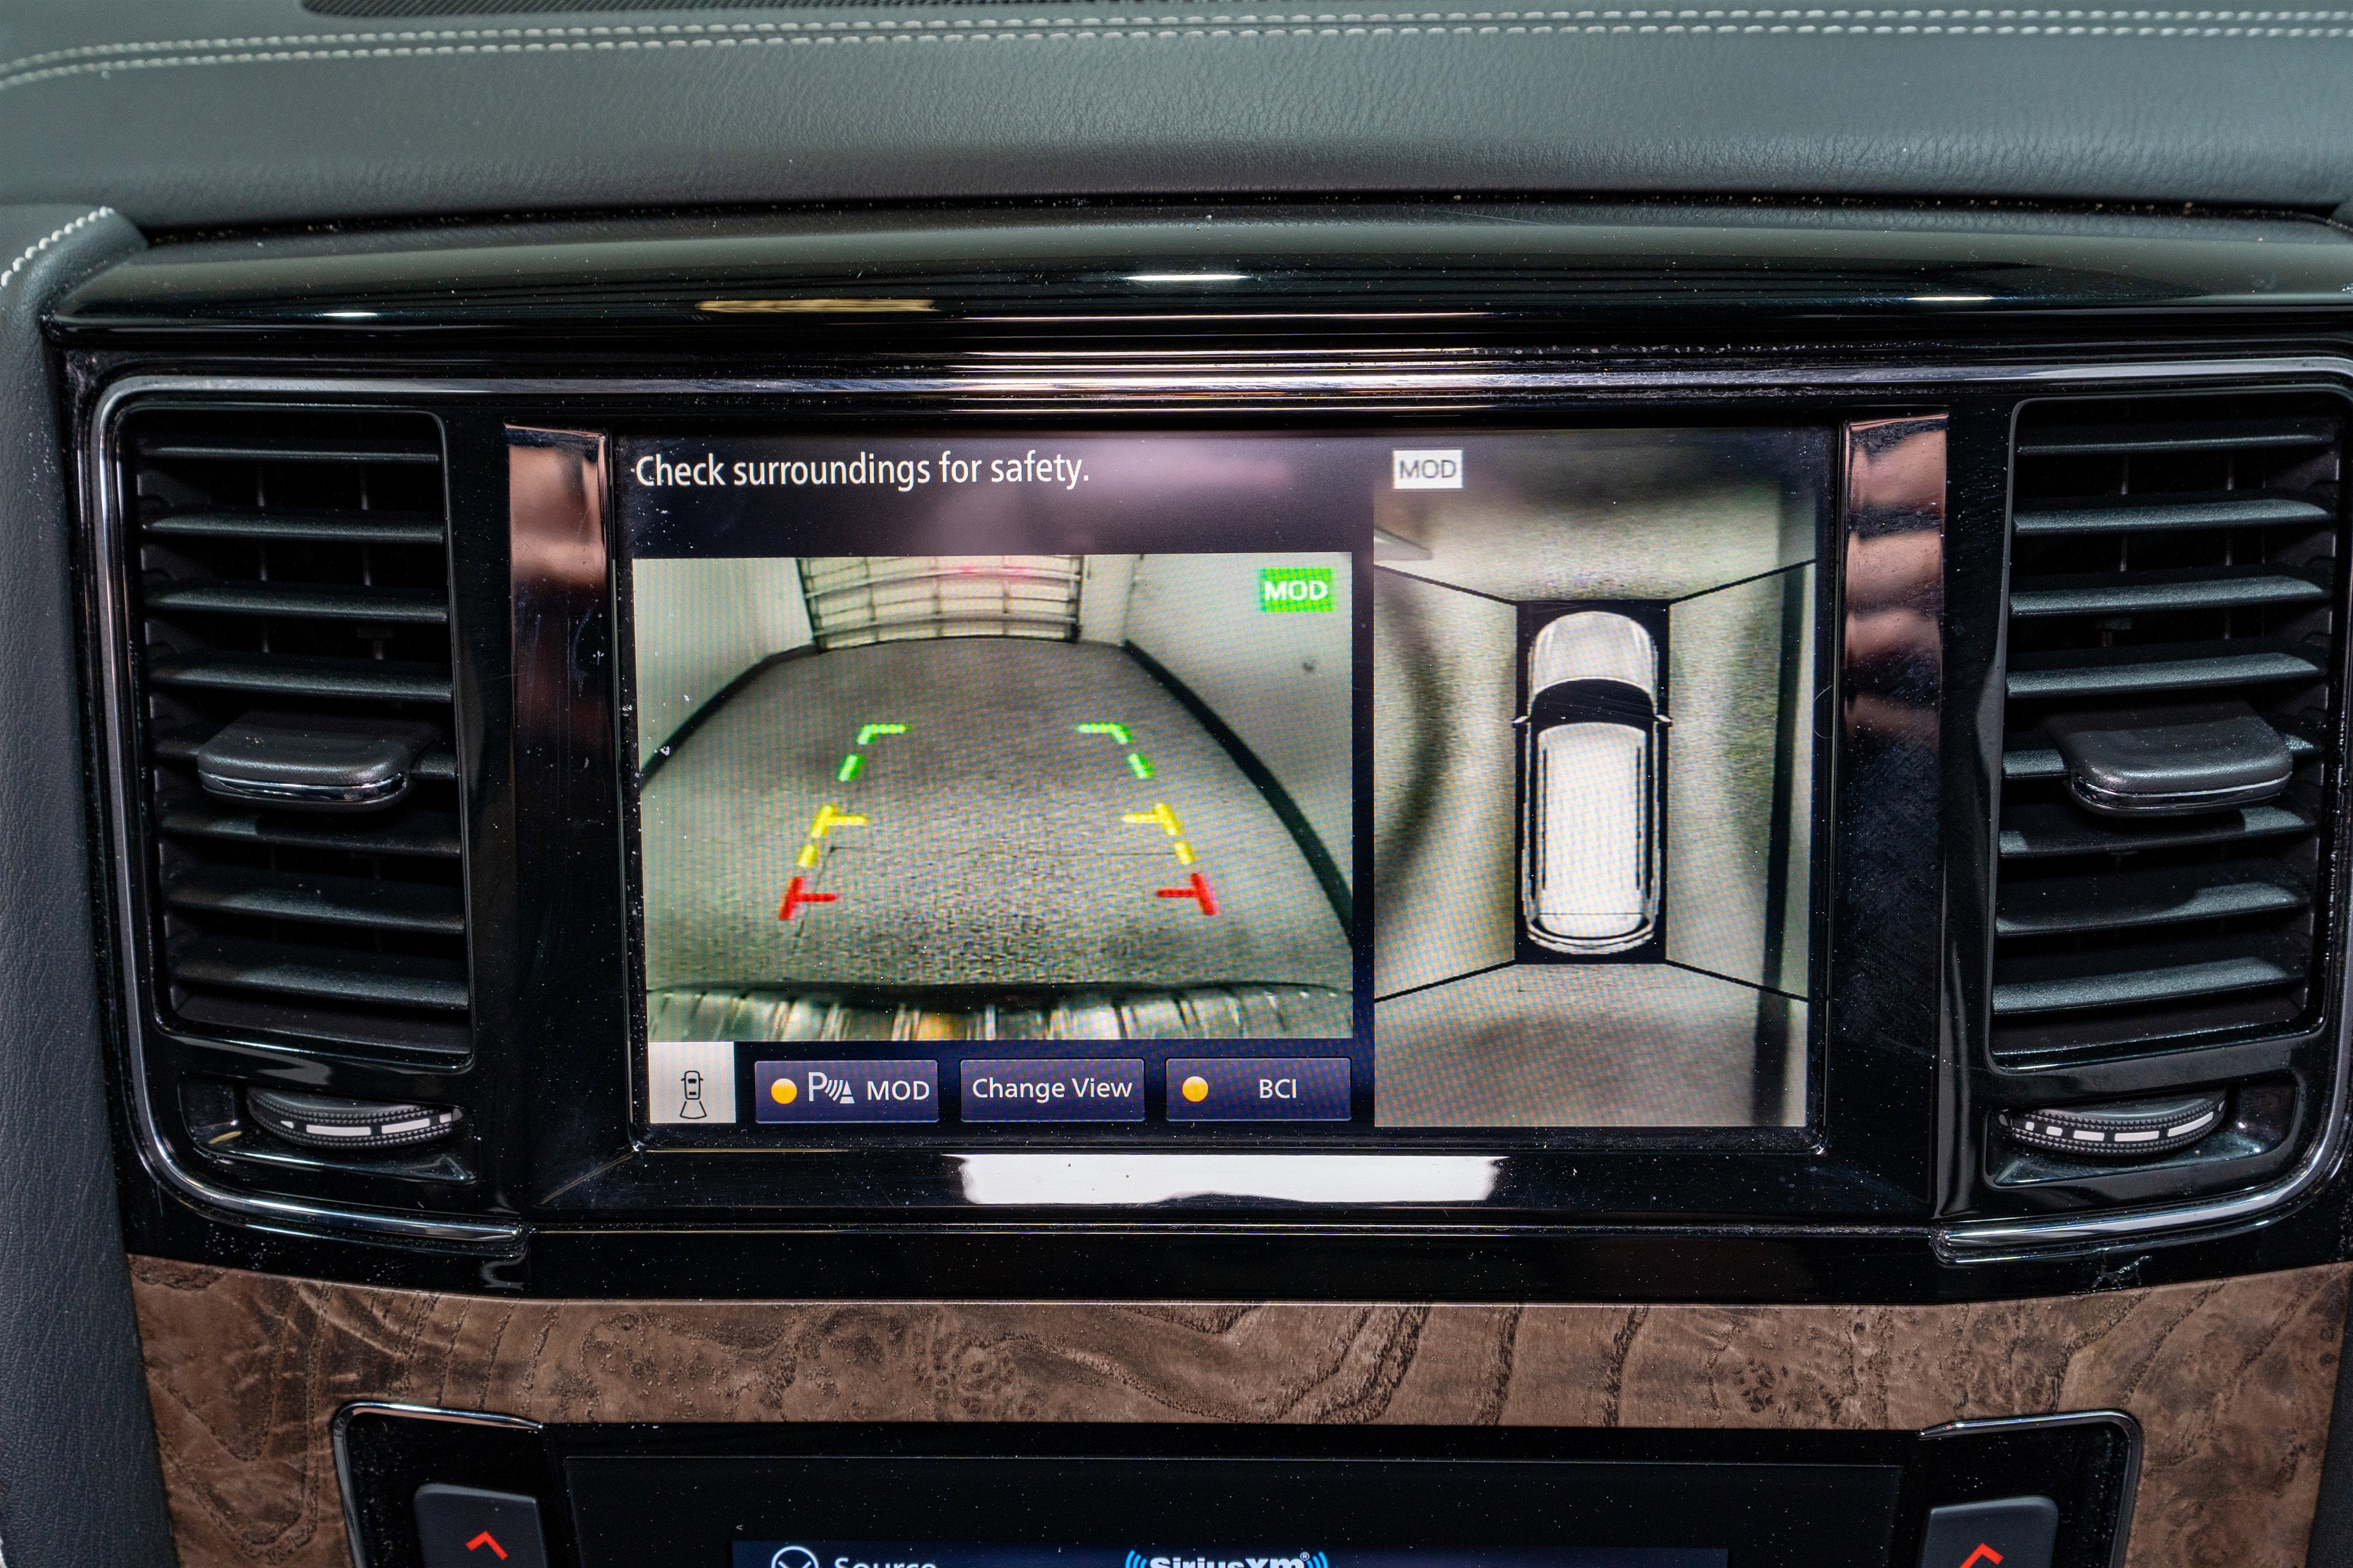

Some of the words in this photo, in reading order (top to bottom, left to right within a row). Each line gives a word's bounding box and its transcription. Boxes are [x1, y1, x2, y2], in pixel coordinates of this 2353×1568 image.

[636, 453, 726, 486] Check
[734, 451, 931, 492] surroundings
[939, 450, 982, 483] for
[991, 450, 1089, 490] safety.
[1399, 459, 1456, 478] MOD
[1264, 580, 1328, 601] MOD
[867, 1080, 930, 1101] MOD
[973, 1077, 1065, 1103] Change
[1071, 1077, 1133, 1098] View
[1260, 1078, 1297, 1099] BCI
